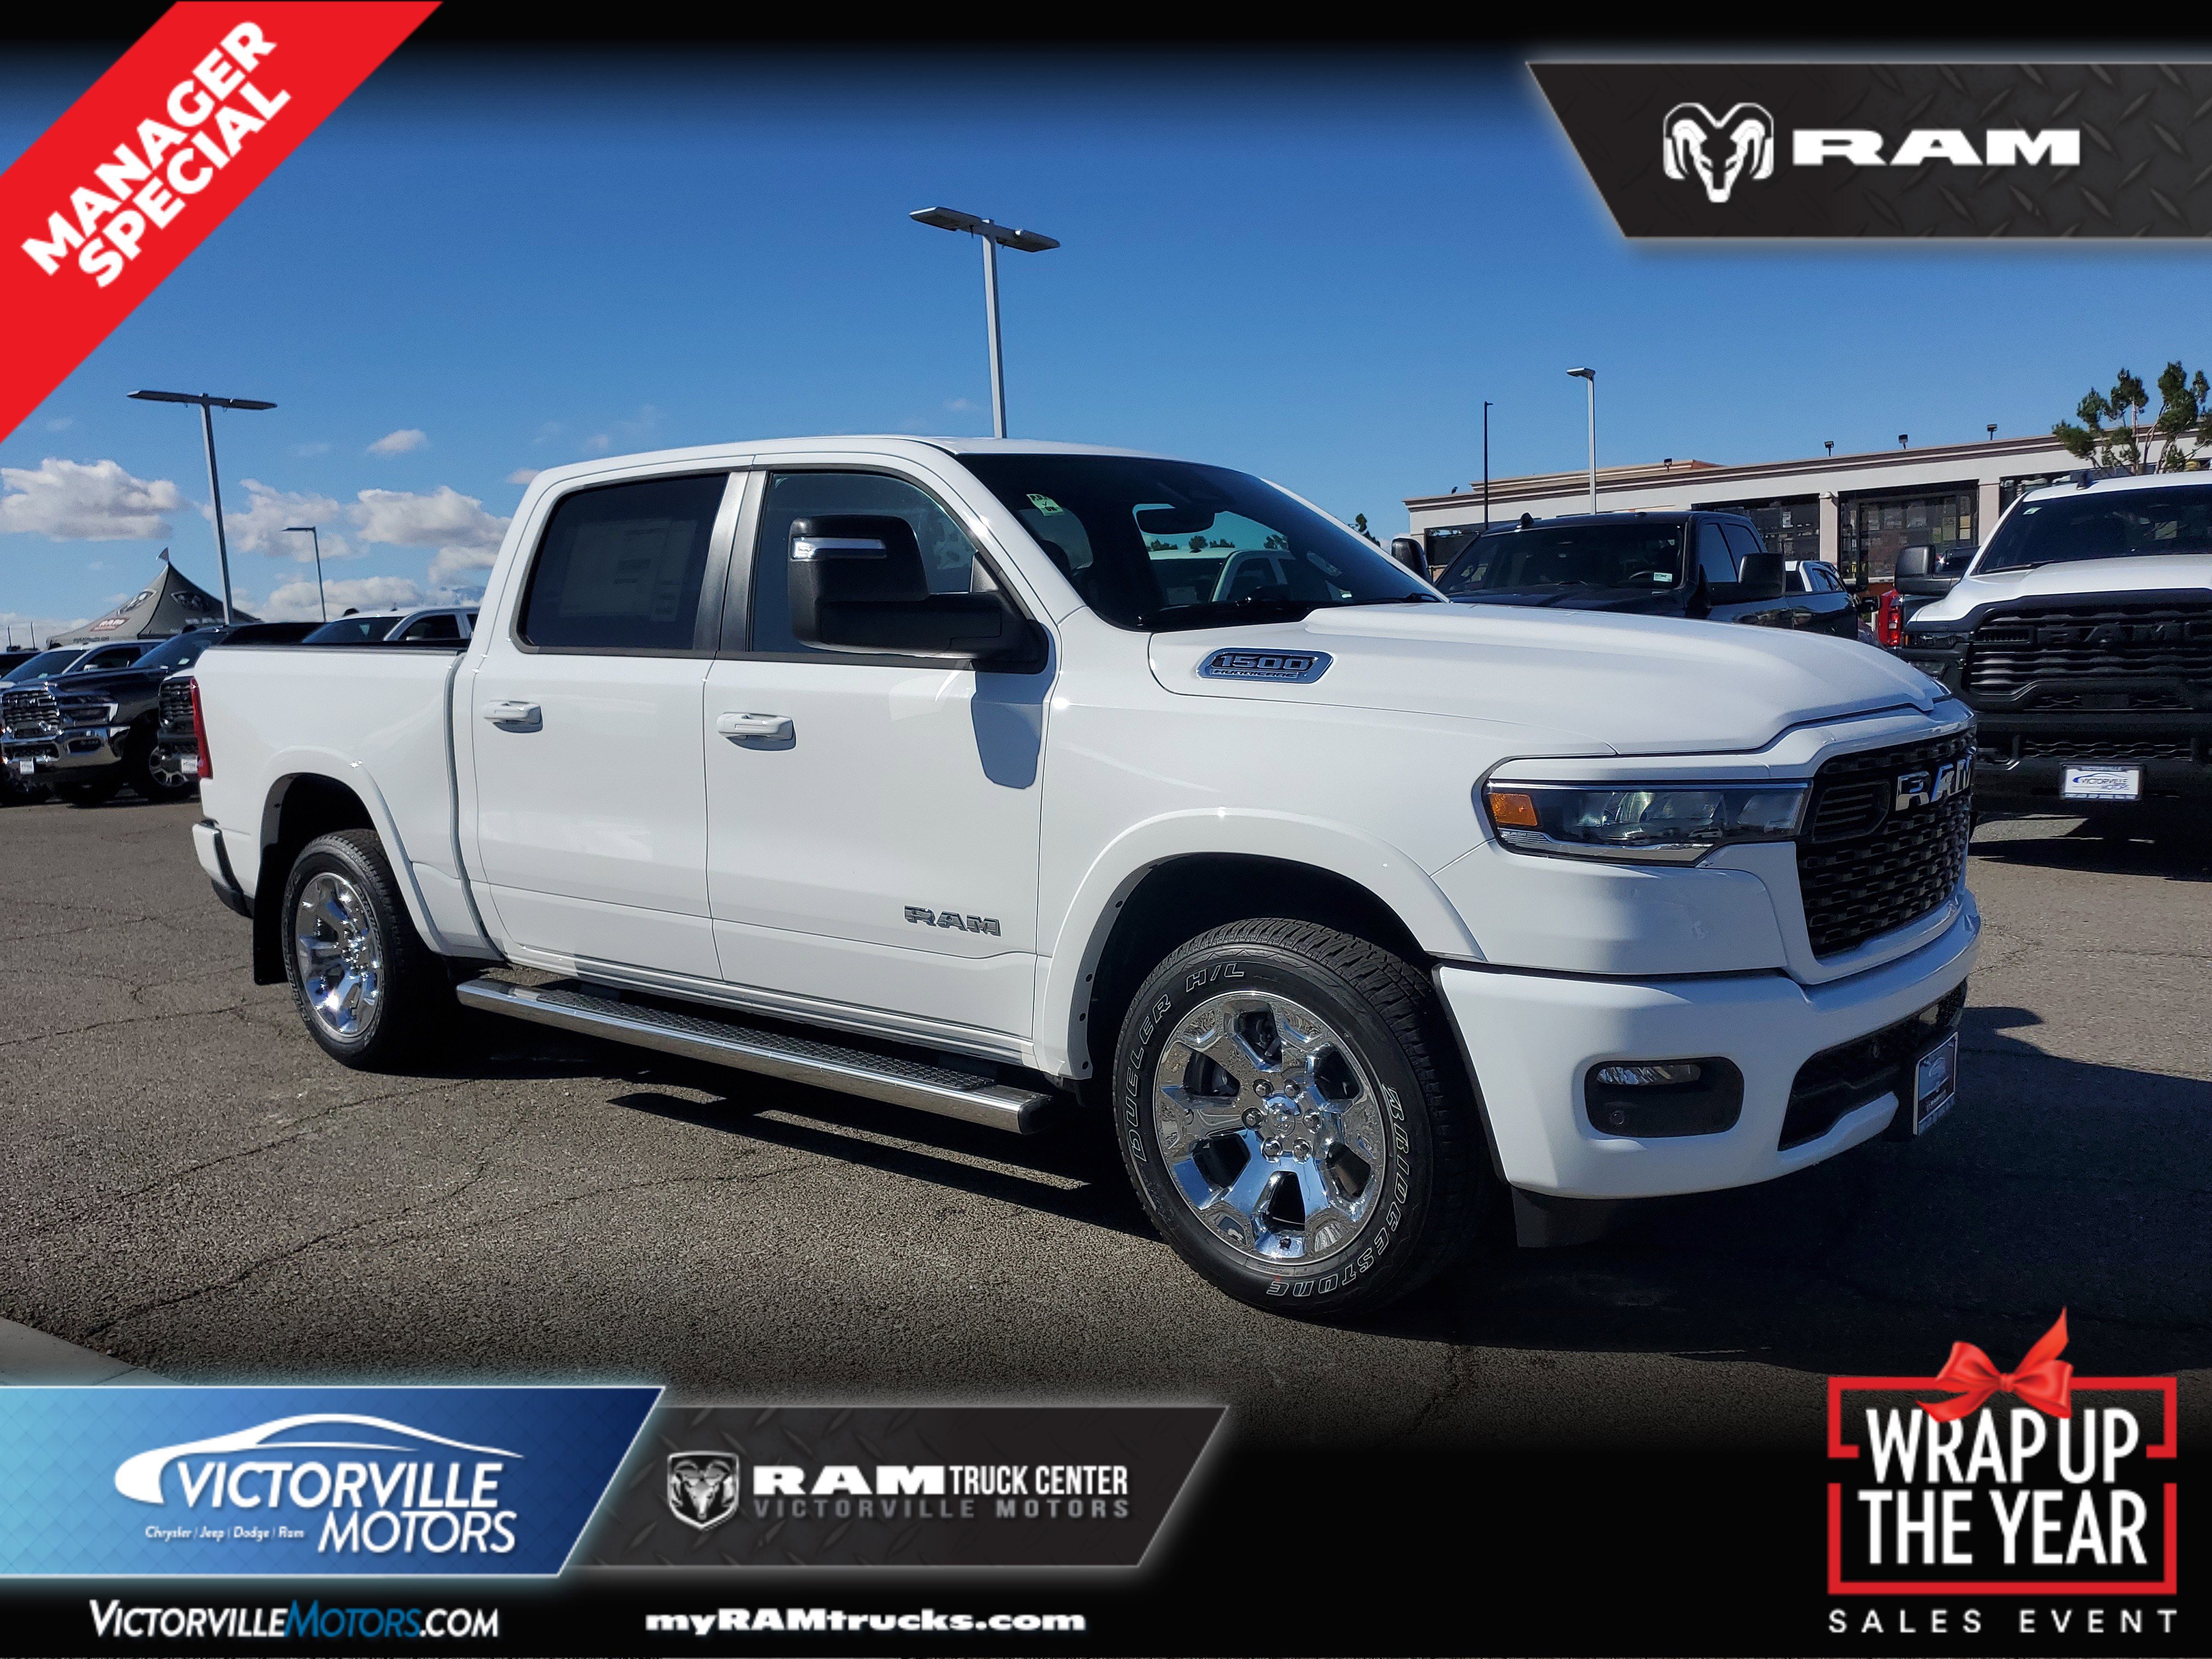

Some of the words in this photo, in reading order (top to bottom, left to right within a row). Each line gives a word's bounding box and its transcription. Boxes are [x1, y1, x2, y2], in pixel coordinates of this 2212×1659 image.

[1215, 656, 1308, 670] 1500
[905, 905, 1002, 937] RAM
[1125, 992, 1172, 1163] DUELER
[1186, 963, 1245, 994] H/L
[1267, 1083, 1410, 1297] BRIDGESTONE
